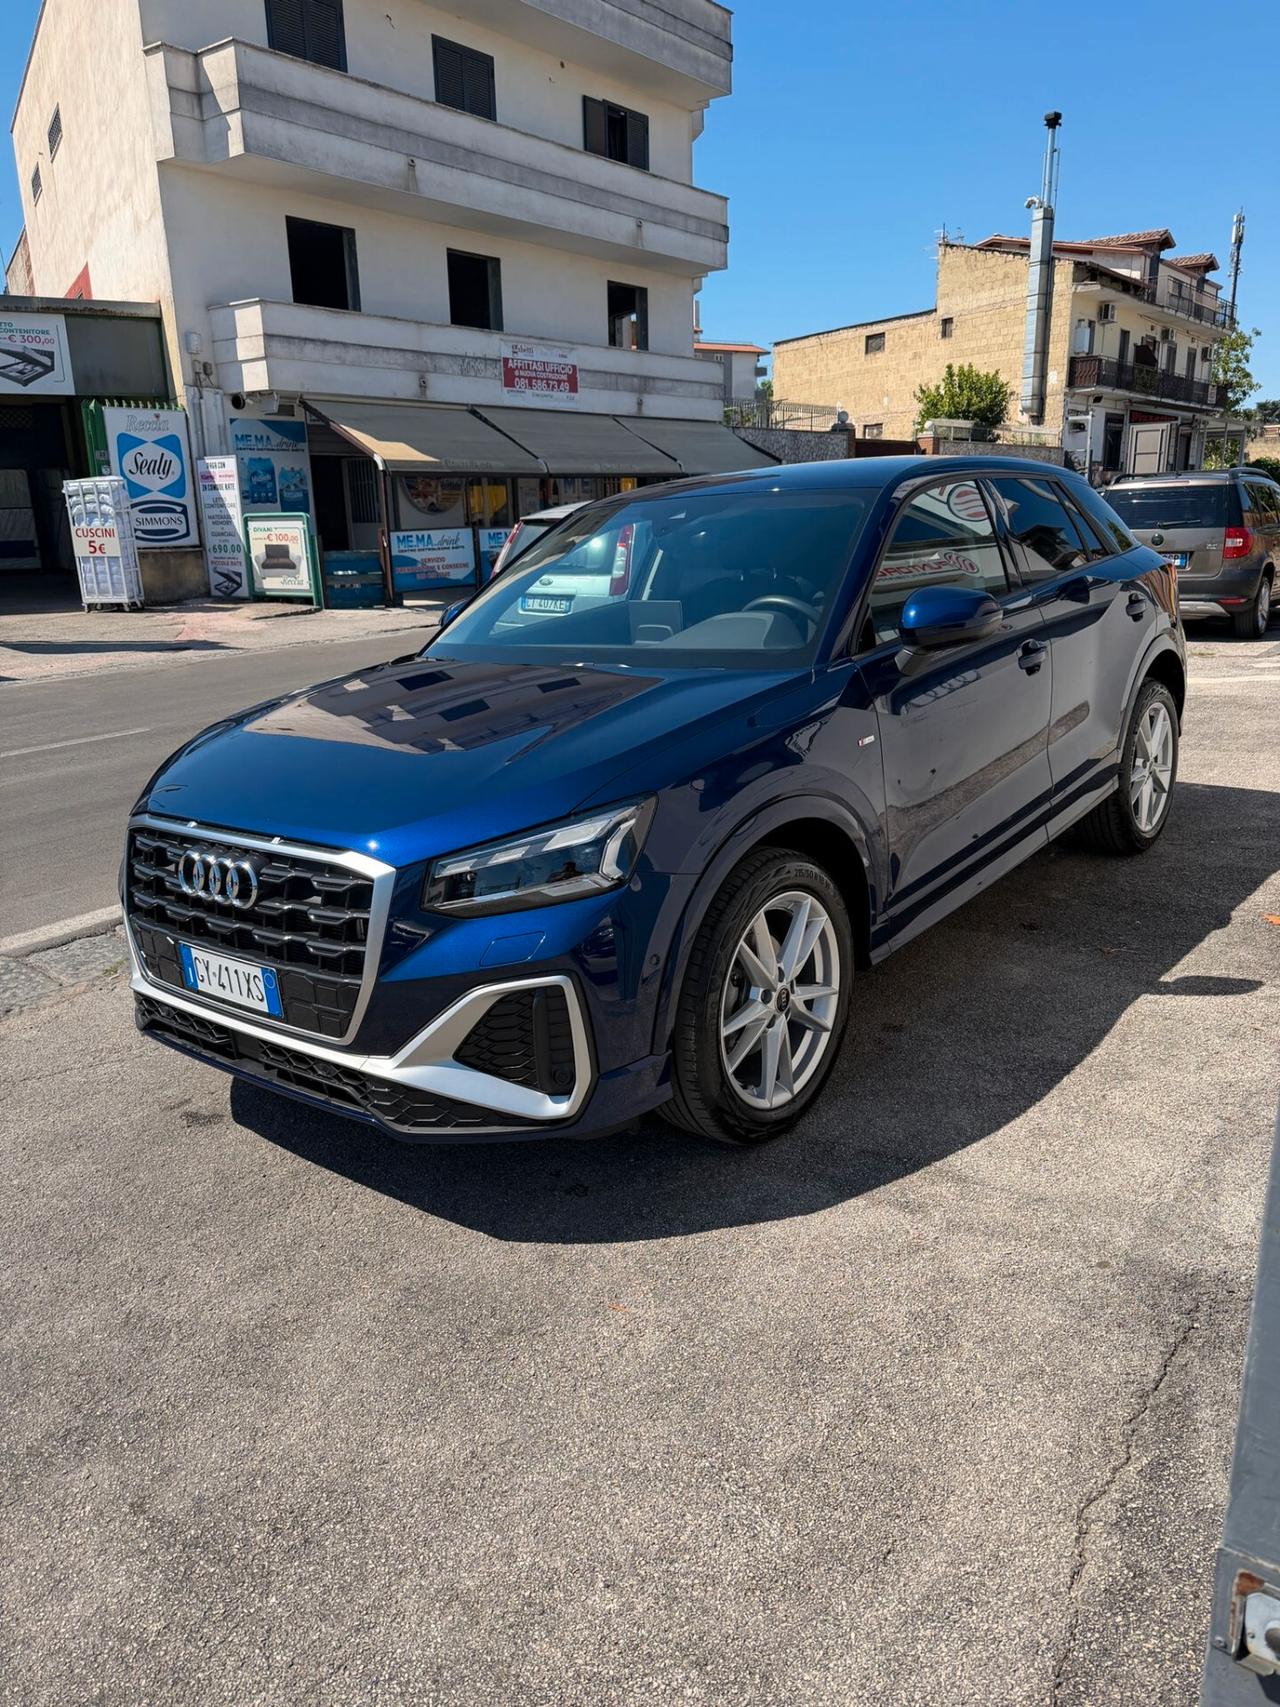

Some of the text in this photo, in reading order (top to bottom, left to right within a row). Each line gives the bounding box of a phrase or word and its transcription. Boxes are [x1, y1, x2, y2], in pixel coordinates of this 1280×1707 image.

[507, 358, 573, 375] AFFITTASI UFFICIO
[128, 451, 173, 480] Sealy
[135, 515, 184, 527] SIMMONS
[75, 527, 116, 538] CUSCINI
[218, 964, 264, 1002] 411XS
